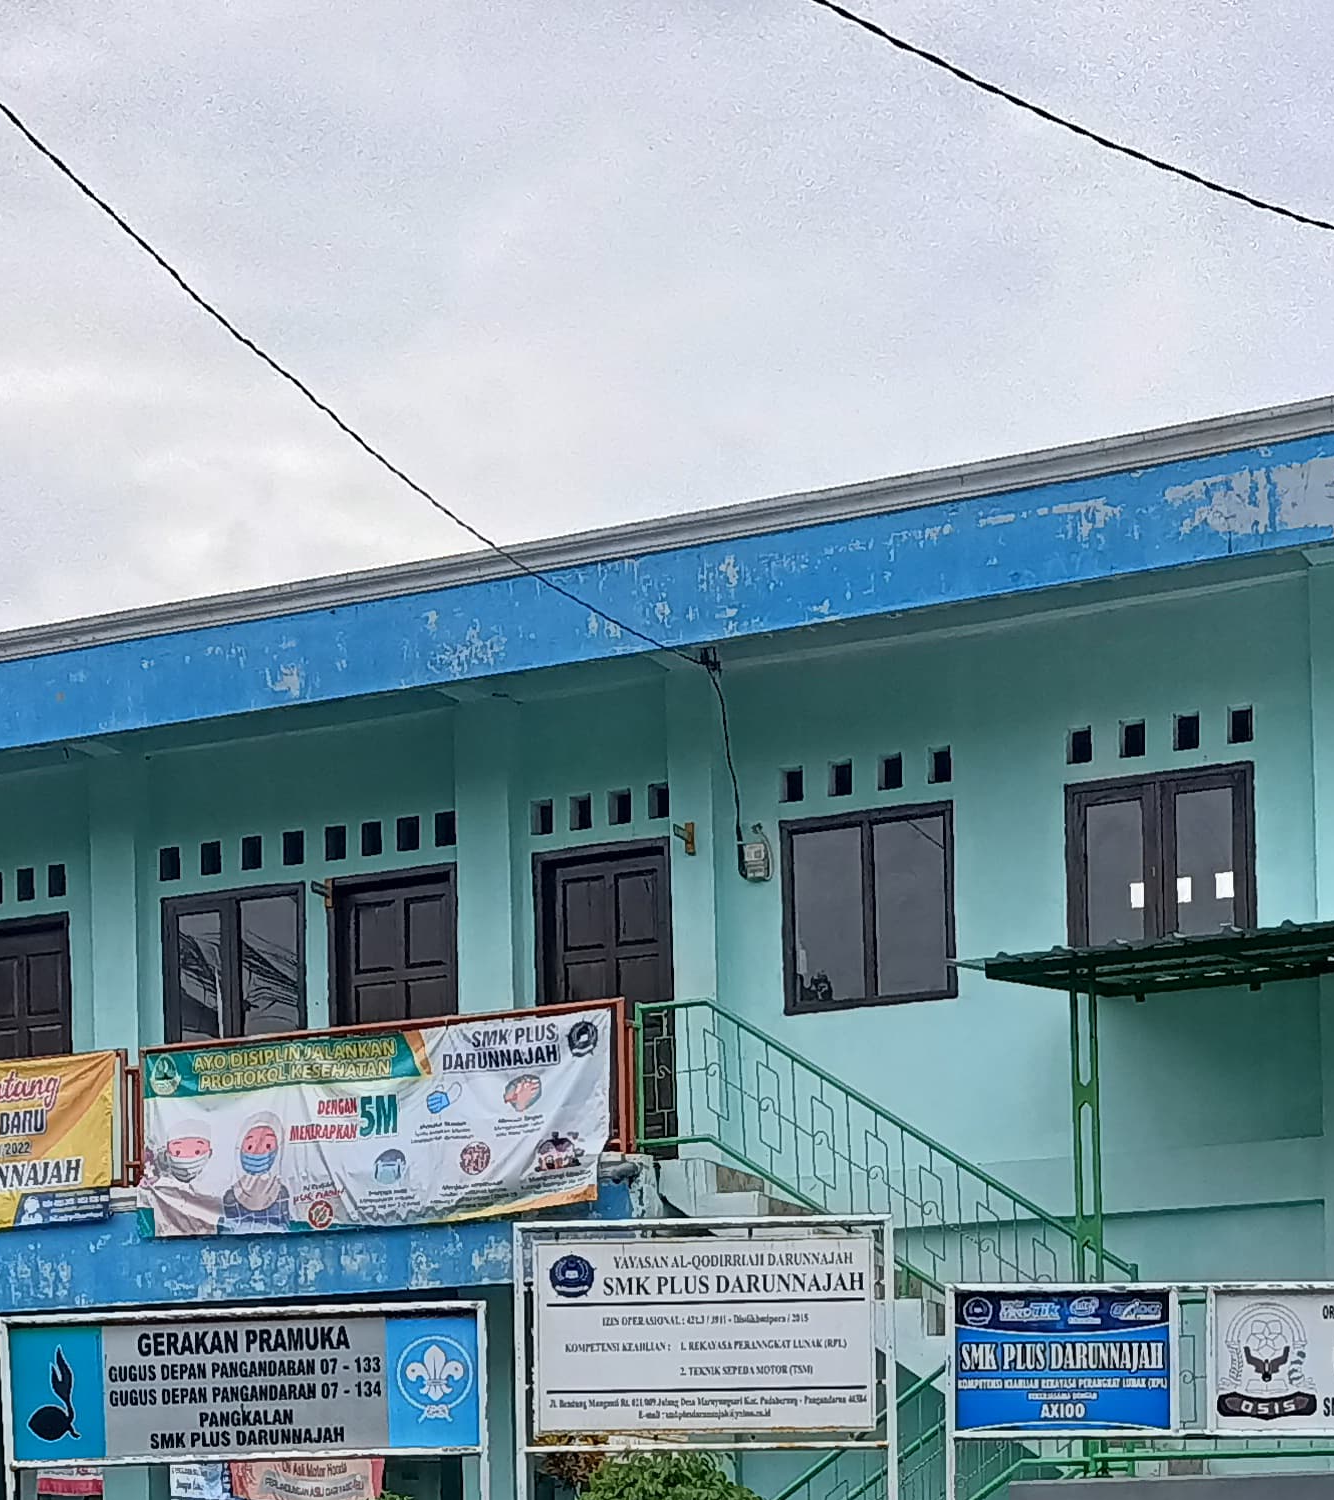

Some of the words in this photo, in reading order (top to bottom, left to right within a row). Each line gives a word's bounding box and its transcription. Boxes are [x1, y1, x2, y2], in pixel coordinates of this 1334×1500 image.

[471, 1028, 511, 1048] SMK
[514, 1022, 558, 1045] PLUS
[194, 1054, 226, 1073] AYO
[230, 1044, 300, 1069] DISIPLIN
[304, 1039, 397, 1062] JALANKAN
[442, 1044, 558, 1071] DARUNNAJAH
[200, 1069, 286, 1091] PROTOKOL
[290, 1060, 391, 1080] KESEHATAN
[317, 1097, 358, 1115] DENGAN
[359, 1094, 399, 1138] 5M
[289, 1123, 358, 1142] MENERAPKAN
[613, 1255, 668, 1269] YAYASAN
[767, 1252, 854, 1266] DARUNNAJAH
[603, 1276, 651, 1296] SMK
[657, 1275, 710, 1295] PLUS
[716, 1272, 865, 1294] DARUNNAJAH
[602, 1316, 620, 1326] IZIN
[621, 1315, 681, 1326] OPERASIONAL
[137, 1330, 239, 1357] GERAKAN
[245, 1326, 351, 1354] PRAMUKA
[565, 1342, 619, 1353] KOMPETENSI
[621, 1342, 667, 1352] KEAHLIAN
[689, 1340, 732, 1351] REKAYASA
[792, 1338, 823, 1349] LUNAK
[960, 1343, 998, 1370] SMK
[1003, 1343, 1046, 1370] PLUS
[1050, 1341, 1164, 1373] DARUNNAJAH
[108, 1364, 157, 1383] GUGUS
[160, 1362, 207, 1381] DEPAN
[211, 1358, 316, 1379] PANGANDARAN
[320, 1358, 338, 1375] 07
[354, 1356, 382, 1374] 133
[688, 1366, 721, 1376] TEKNIK
[722, 1365, 756, 1375] SEPEDA
[756, 1365, 788, 1375] MOTOR
[109, 1388, 157, 1407] GUGUS
[161, 1387, 208, 1406] DEPAN
[212, 1383, 317, 1404] PANGANDARAN
[321, 1382, 339, 1399] 07
[354, 1380, 382, 1398] 134
[957, 1379, 1003, 1389] KOMPETENSI
[1041, 1378, 1077, 1389] REKAYASA
[1078, 1378, 1120, 1389] PERANGKAT
[1040, 1403, 1086, 1419] AXIOO
[1239, 1398, 1297, 1414] OSIS
[199, 1408, 294, 1428] PANGKALAN
[150, 1432, 186, 1450] SMK
[191, 1430, 231, 1448] PLUS
[237, 1427, 345, 1446] DARUNNAJAH
